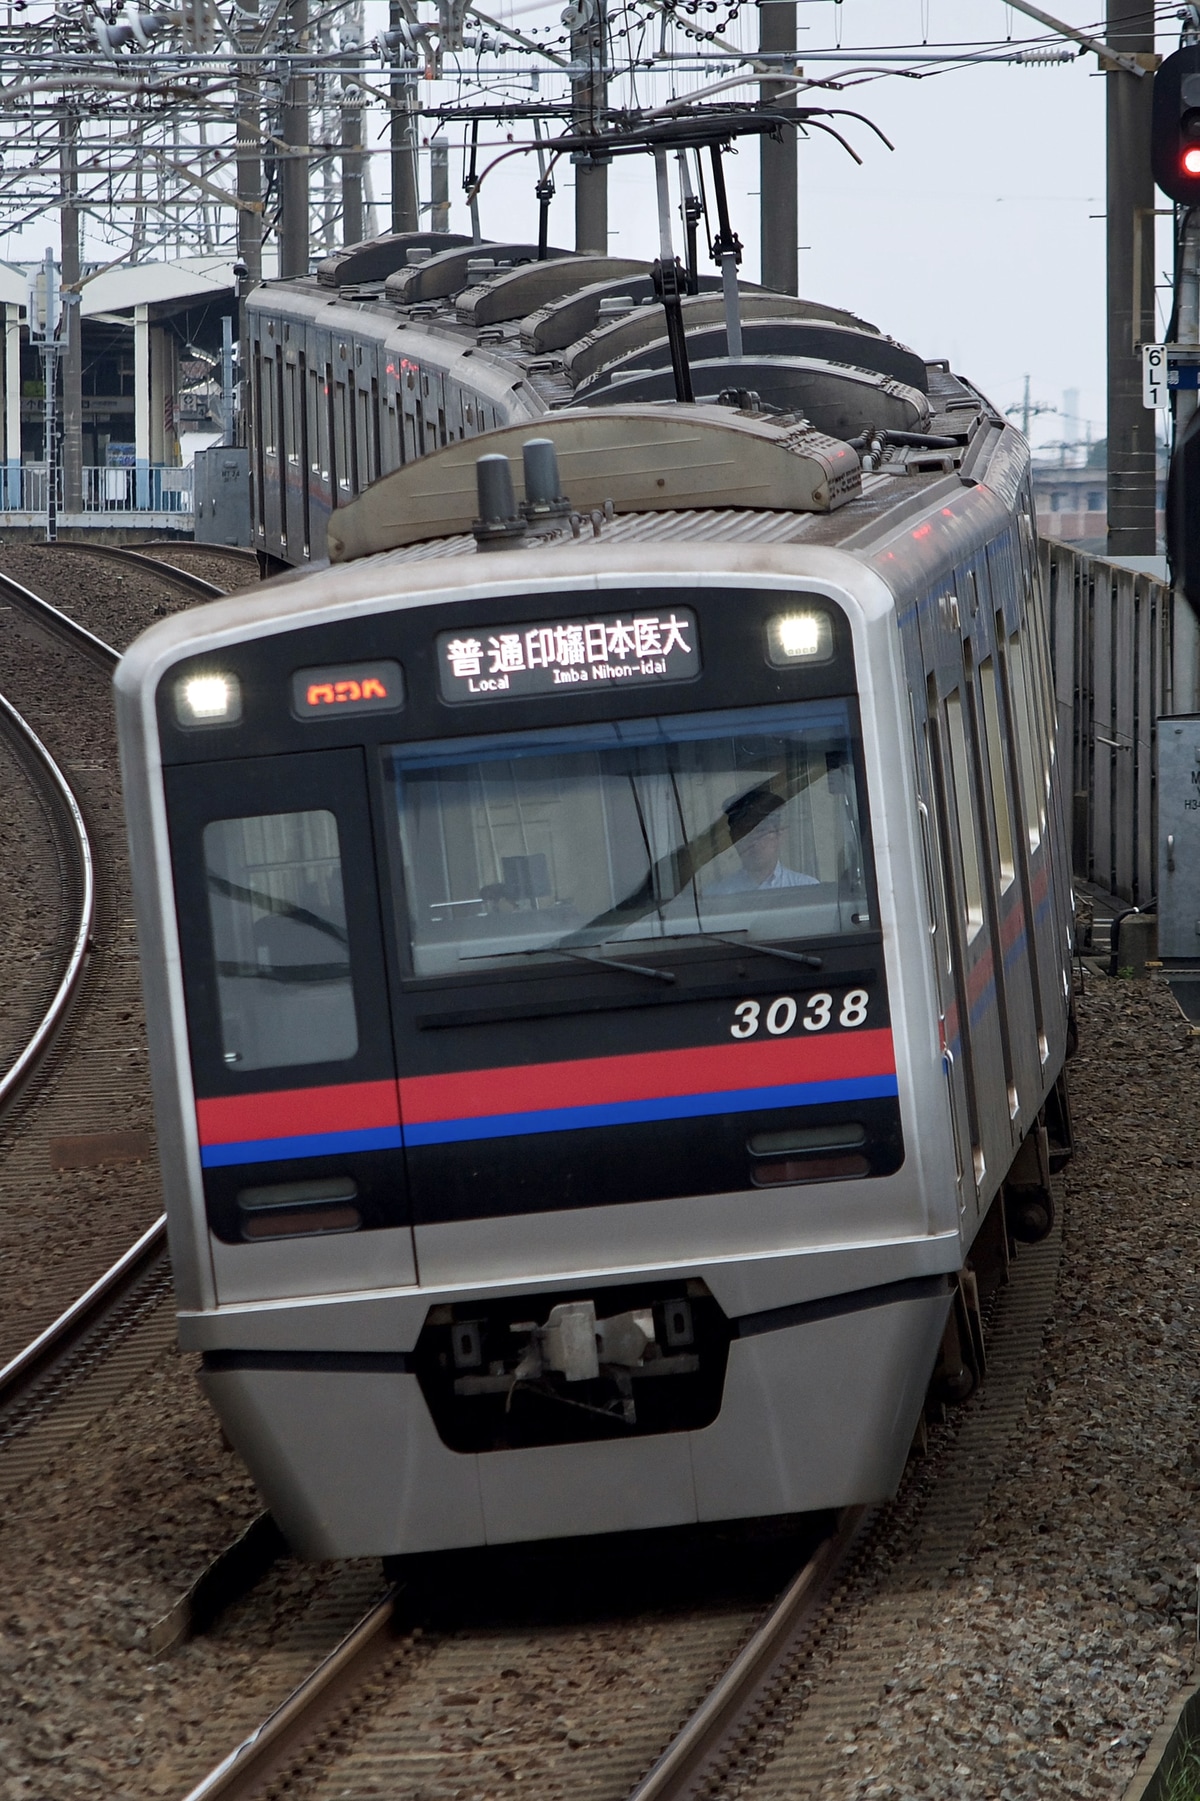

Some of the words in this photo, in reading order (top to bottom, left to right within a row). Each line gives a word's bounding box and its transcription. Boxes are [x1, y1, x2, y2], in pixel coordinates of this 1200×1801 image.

[447, 633, 526, 677] 普通
[468, 674, 510, 693] Local
[553, 668, 588, 684] Imba
[592, 658, 667, 680] Nihon-idai
[730, 989, 869, 1039] 3038
